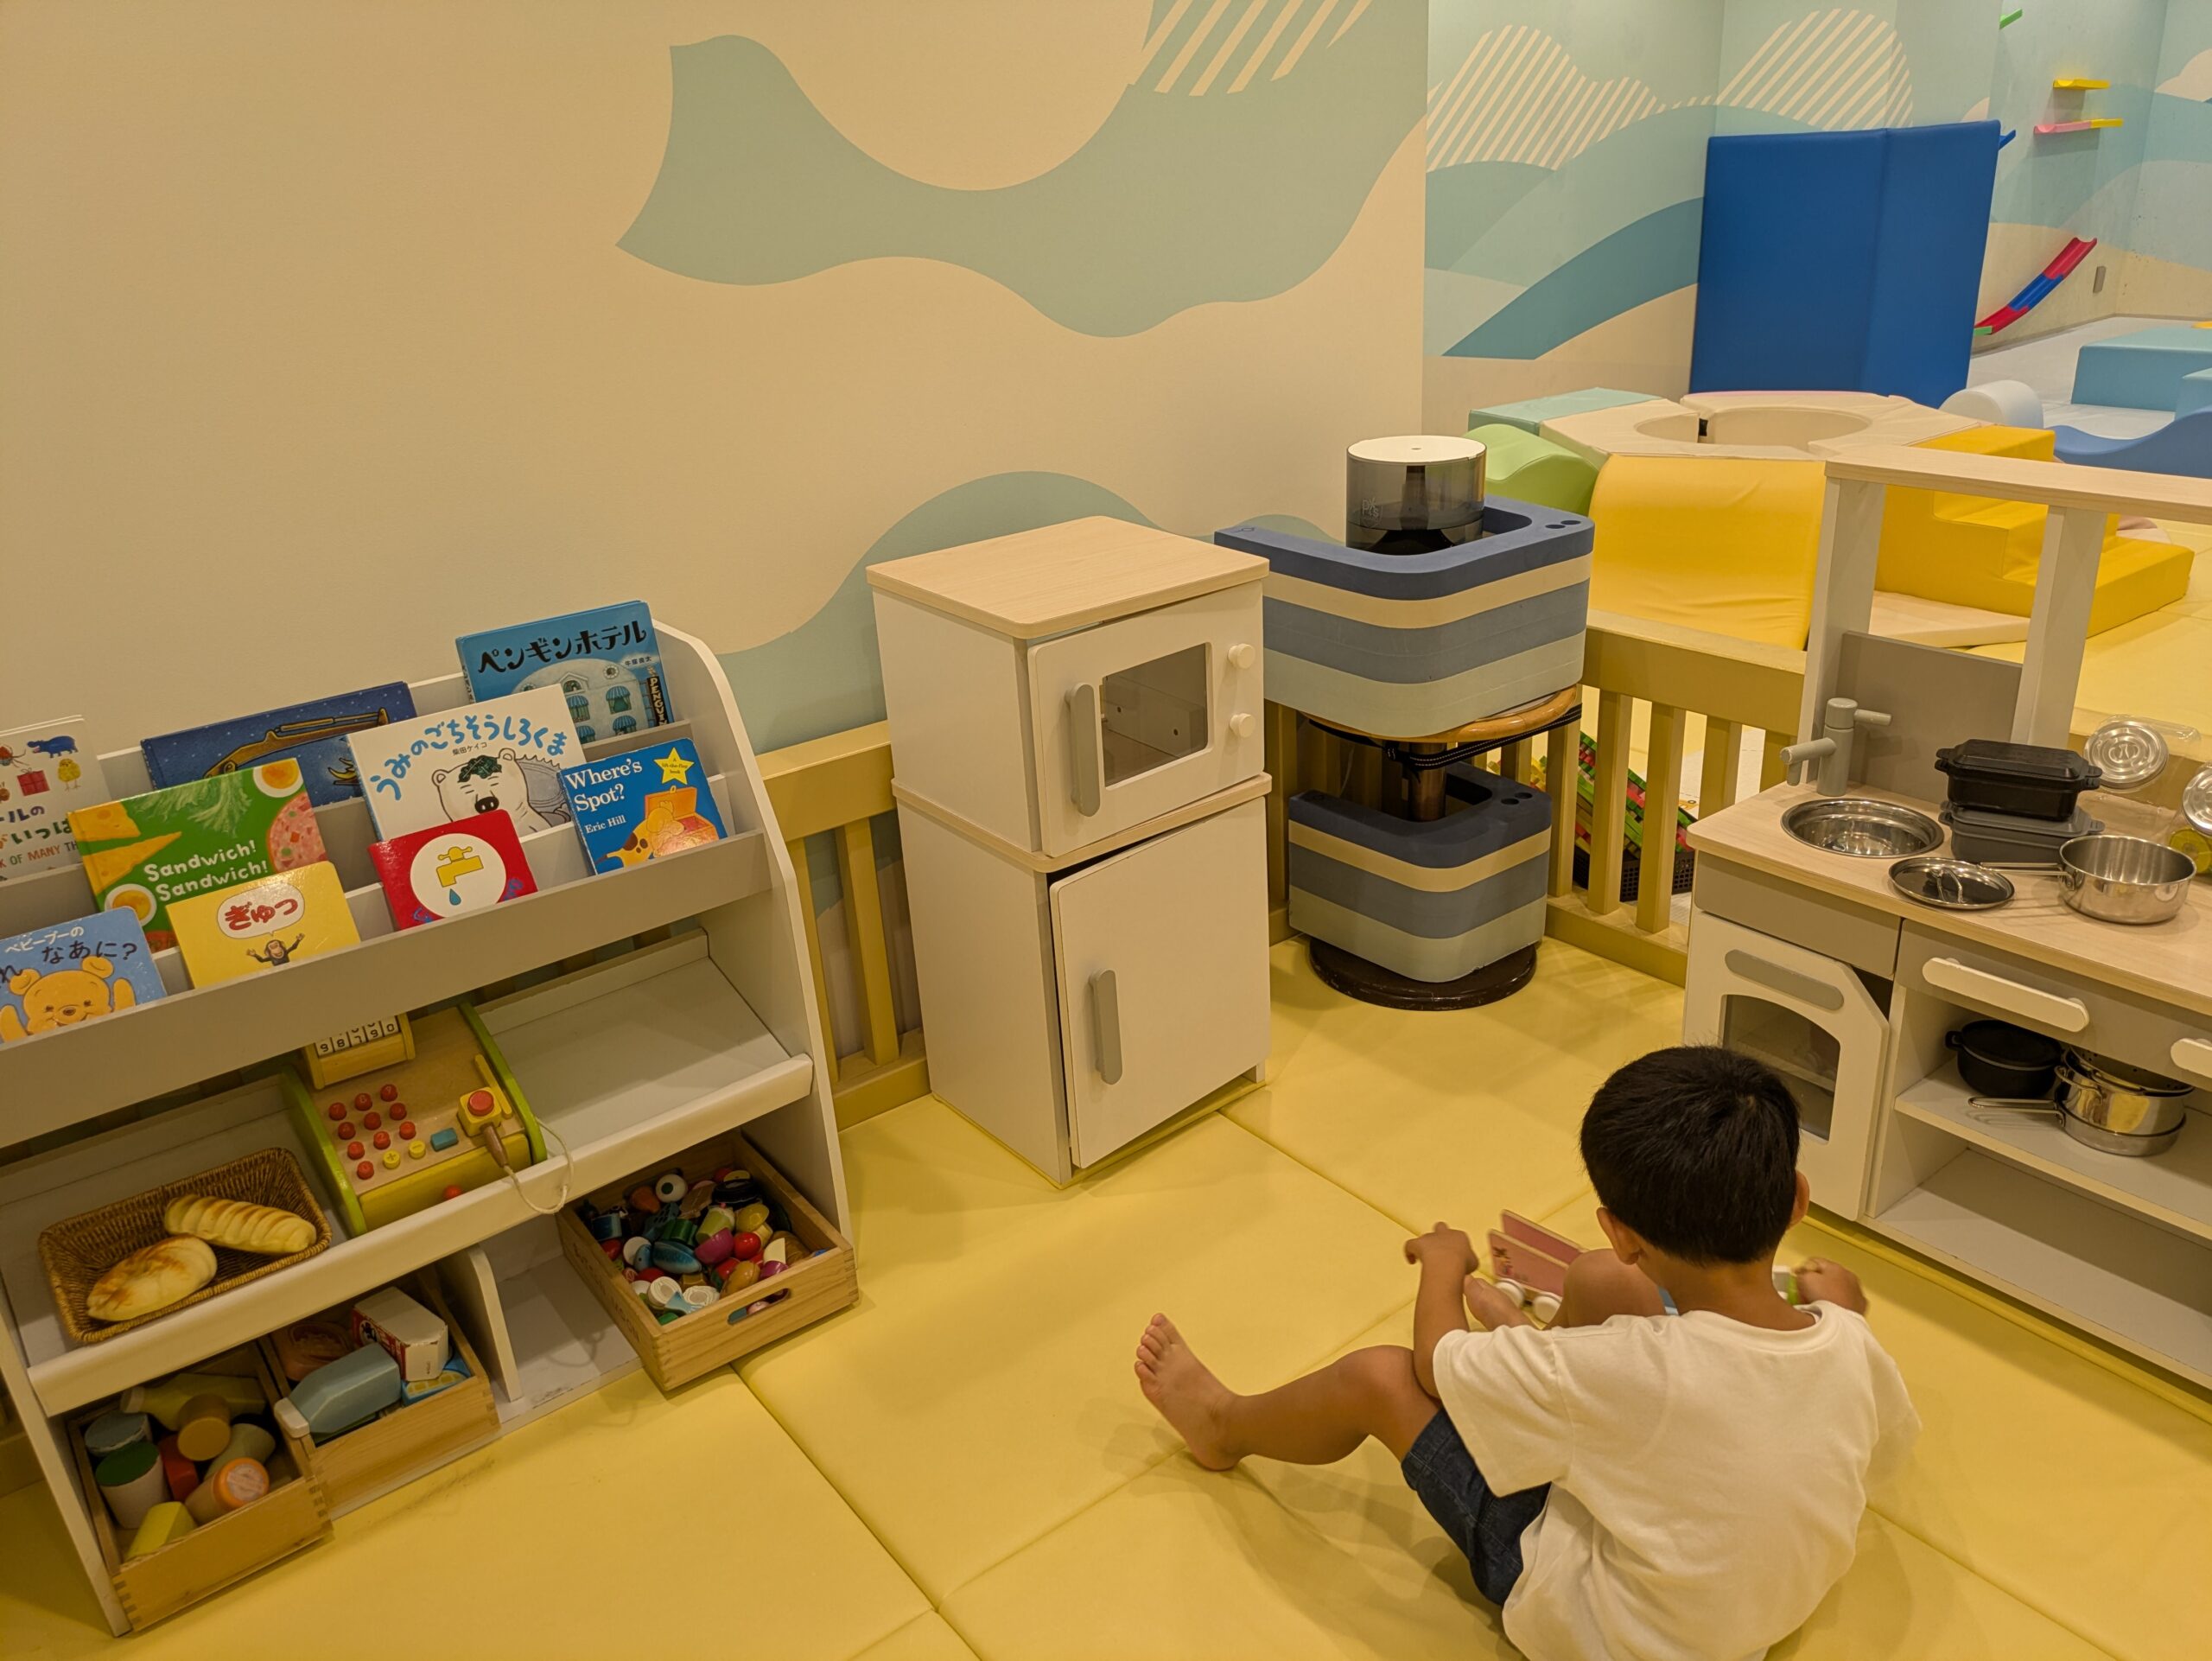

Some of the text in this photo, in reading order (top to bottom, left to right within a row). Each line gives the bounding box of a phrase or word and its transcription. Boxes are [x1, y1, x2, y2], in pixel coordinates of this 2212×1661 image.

[478, 620, 647, 673] ペンギンホテル
[370, 714, 568, 801] うみのごちそうしろくま
[566, 758, 643, 789] Where's
[574, 783, 625, 812] Spot?
[584, 814, 626, 834] Eric Hill
[10, 854, 23, 865] OF
[27, 844, 61, 862] MANY
[143, 839, 257, 882] Sandwich!
[156, 860, 269, 902] Sandwich!
[41, 940, 137, 964] なあに?
